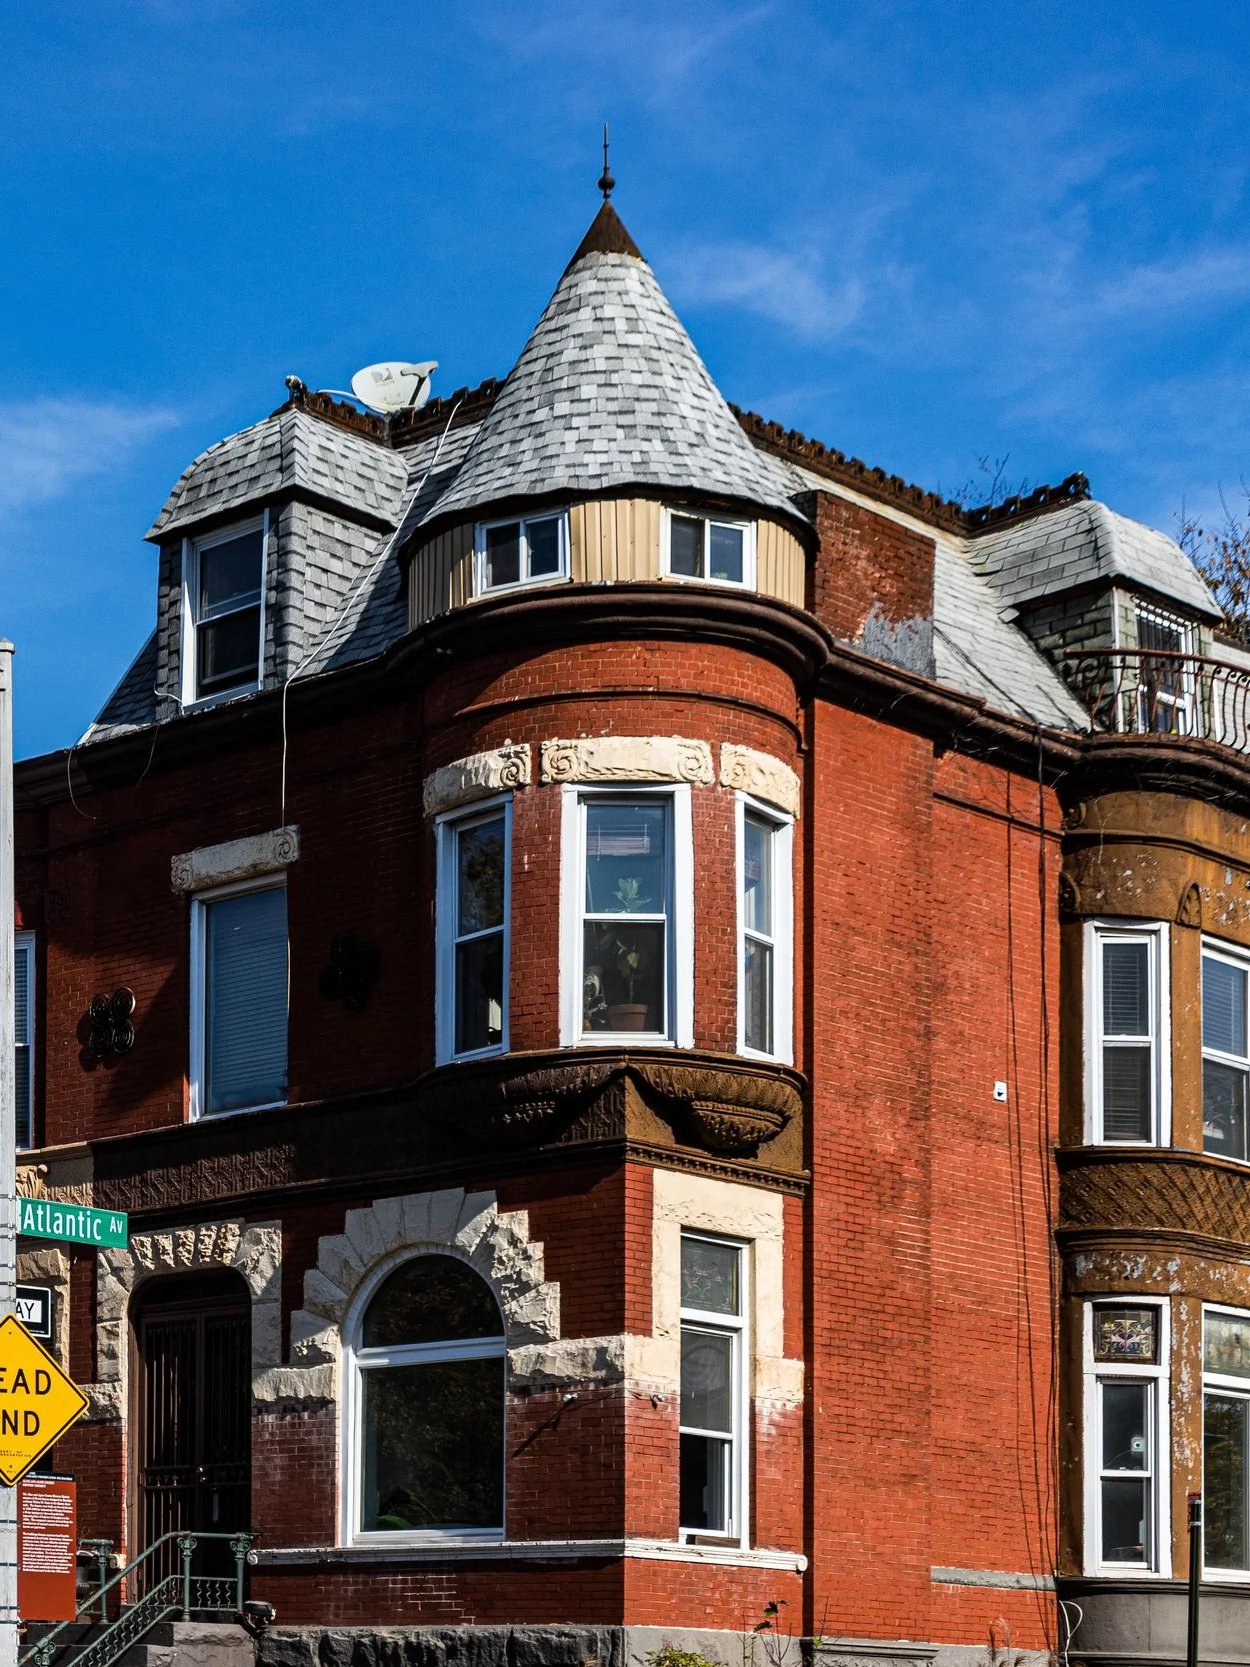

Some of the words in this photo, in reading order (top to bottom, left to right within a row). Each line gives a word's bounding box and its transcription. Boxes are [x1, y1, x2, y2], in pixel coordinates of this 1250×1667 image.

[23, 1203, 102, 1241] Atlantic
[109, 1216, 123, 1234] Av
[15, 1301, 35, 1320] AY
